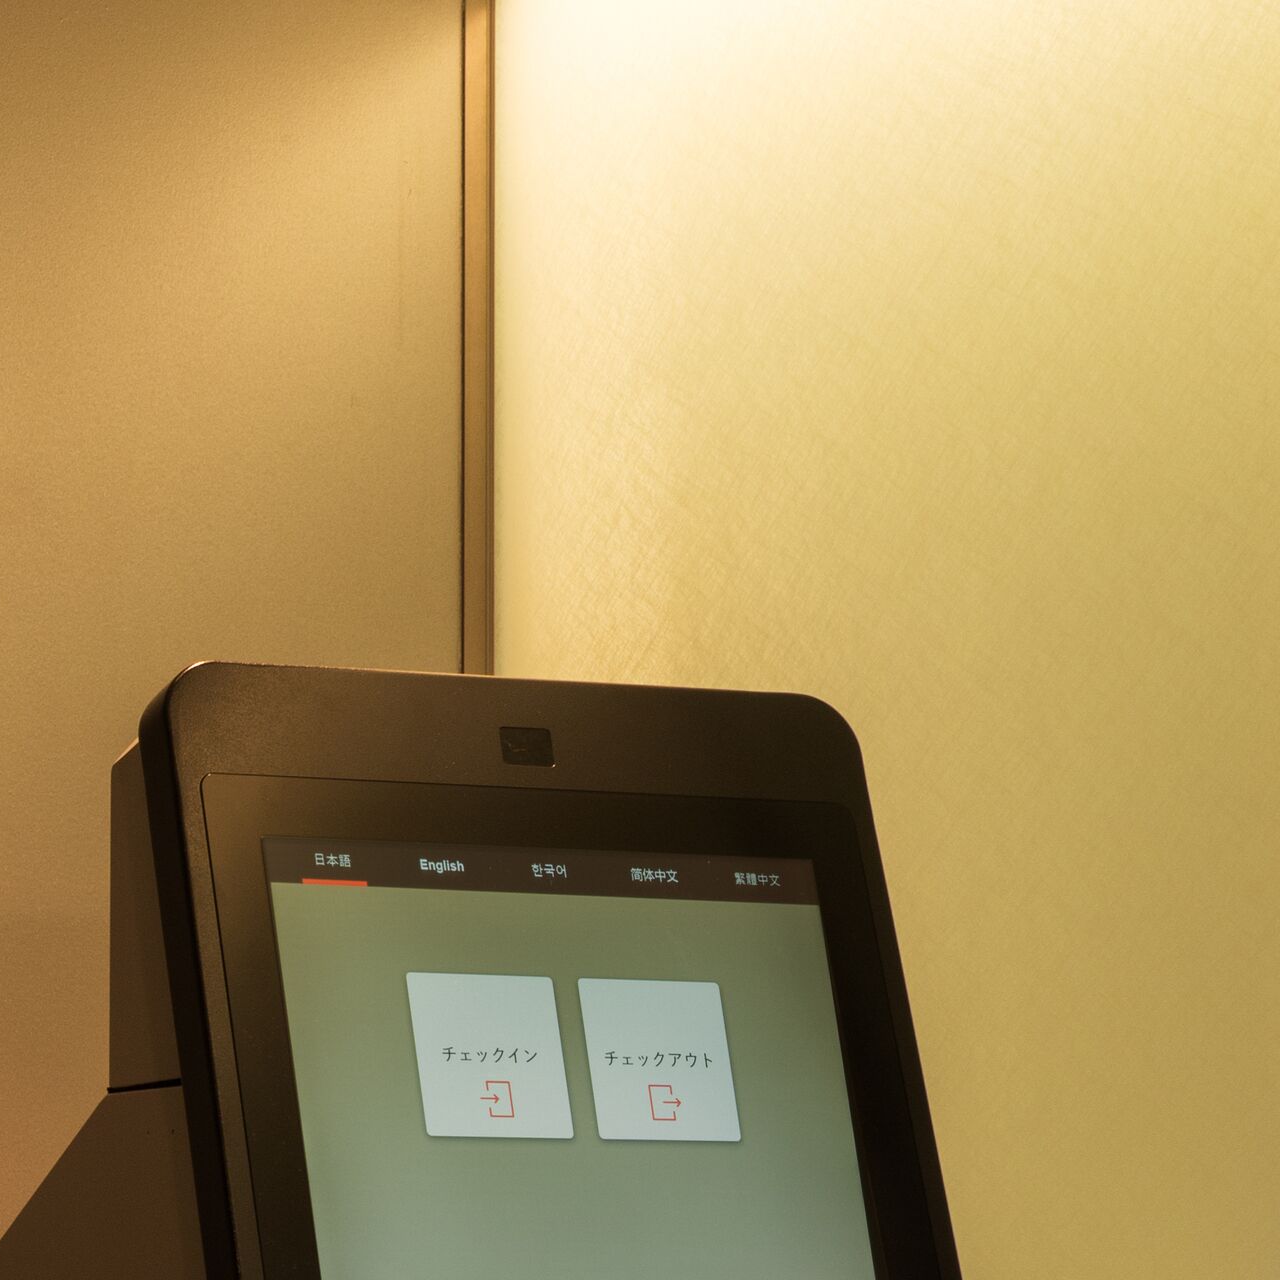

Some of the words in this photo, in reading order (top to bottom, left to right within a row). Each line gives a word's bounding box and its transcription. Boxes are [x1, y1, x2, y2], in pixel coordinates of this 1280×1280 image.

[314, 853, 351, 868] 日本語
[419, 858, 465, 873] English
[531, 862, 568, 879] 한국어
[630, 867, 679, 883] 简体中文
[441, 1046, 538, 1064] チェックイン
[604, 1050, 713, 1068] チェックアウト
